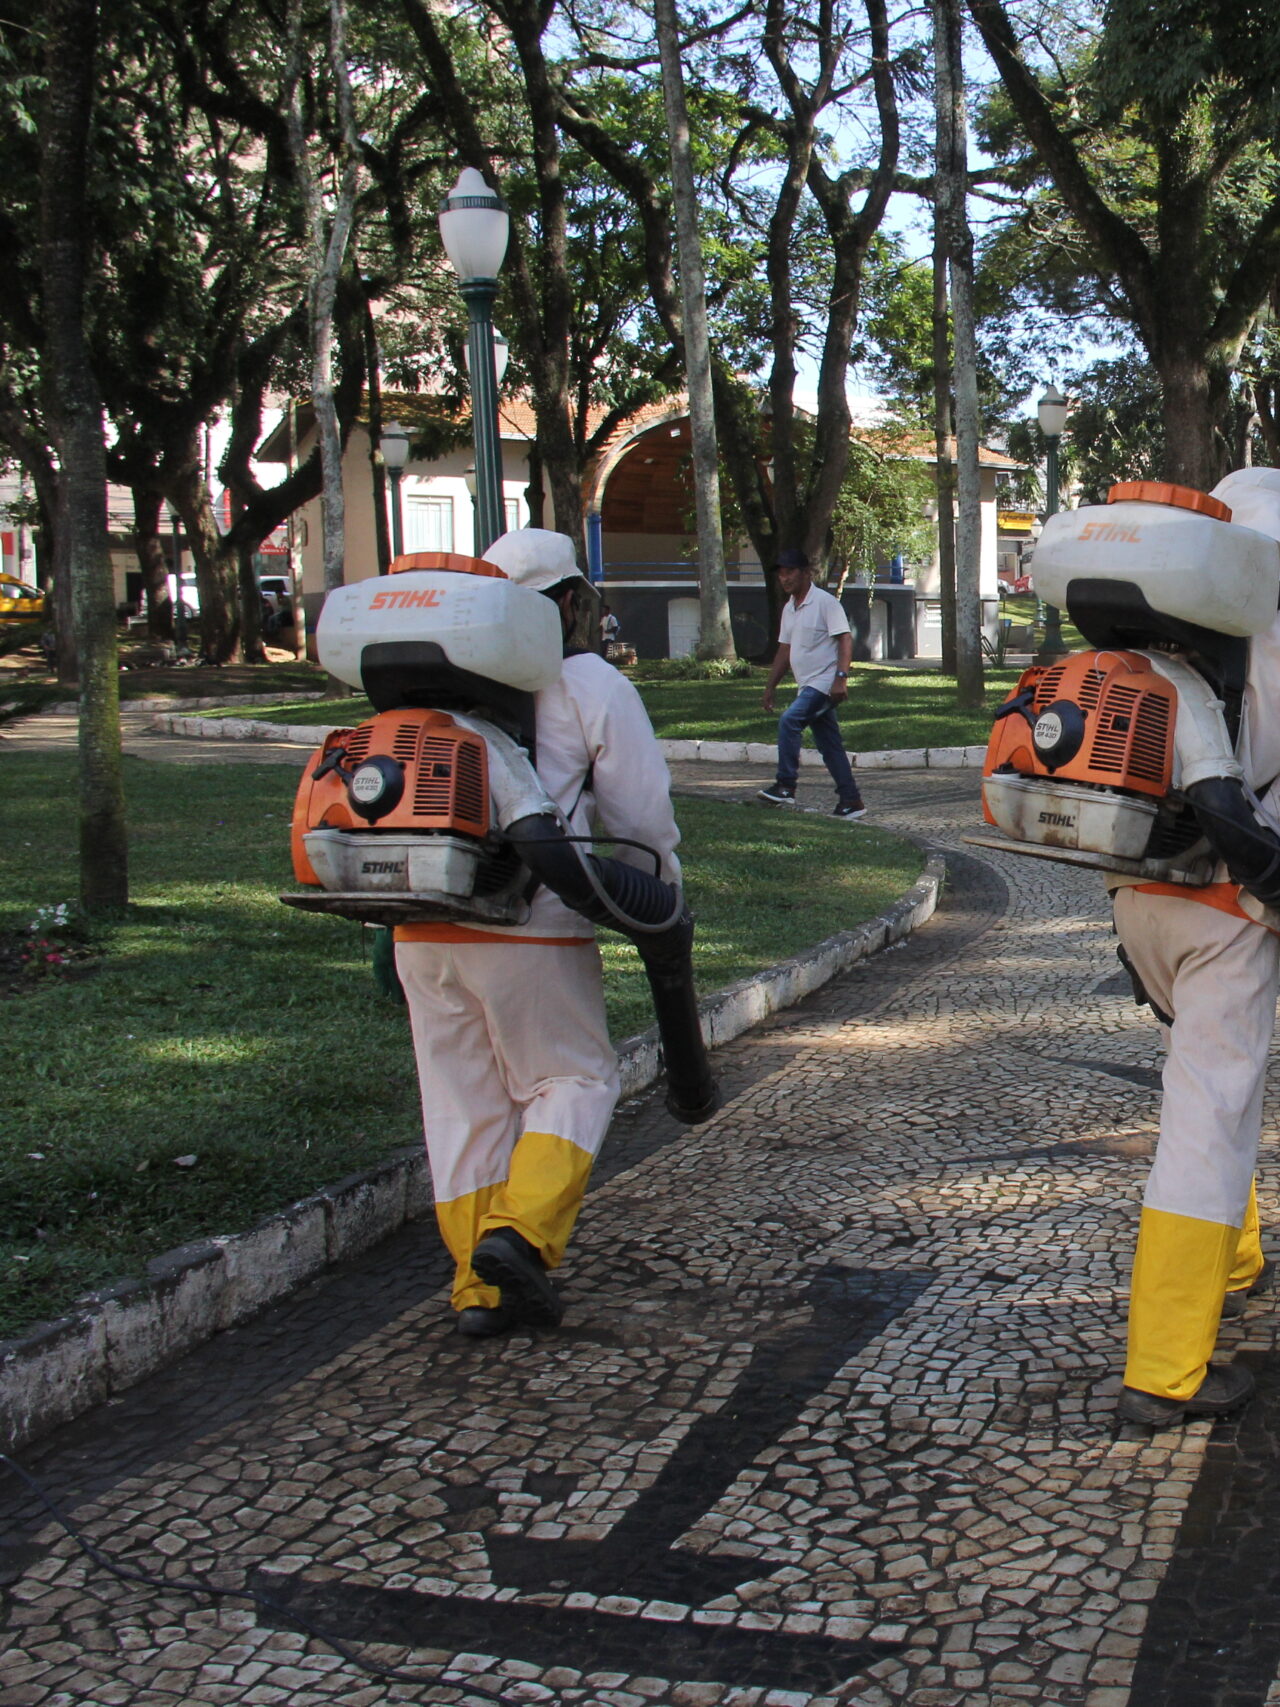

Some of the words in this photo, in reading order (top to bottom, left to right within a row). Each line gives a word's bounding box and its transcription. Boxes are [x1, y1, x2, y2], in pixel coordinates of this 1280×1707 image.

[1078, 522, 1143, 543] STIHL
[368, 590, 442, 610] STIHL
[1036, 722, 1059, 733] STIHL
[354, 776, 381, 785] STIHL
[1038, 811, 1074, 828] STIHL
[361, 861, 402, 874] STIHL
